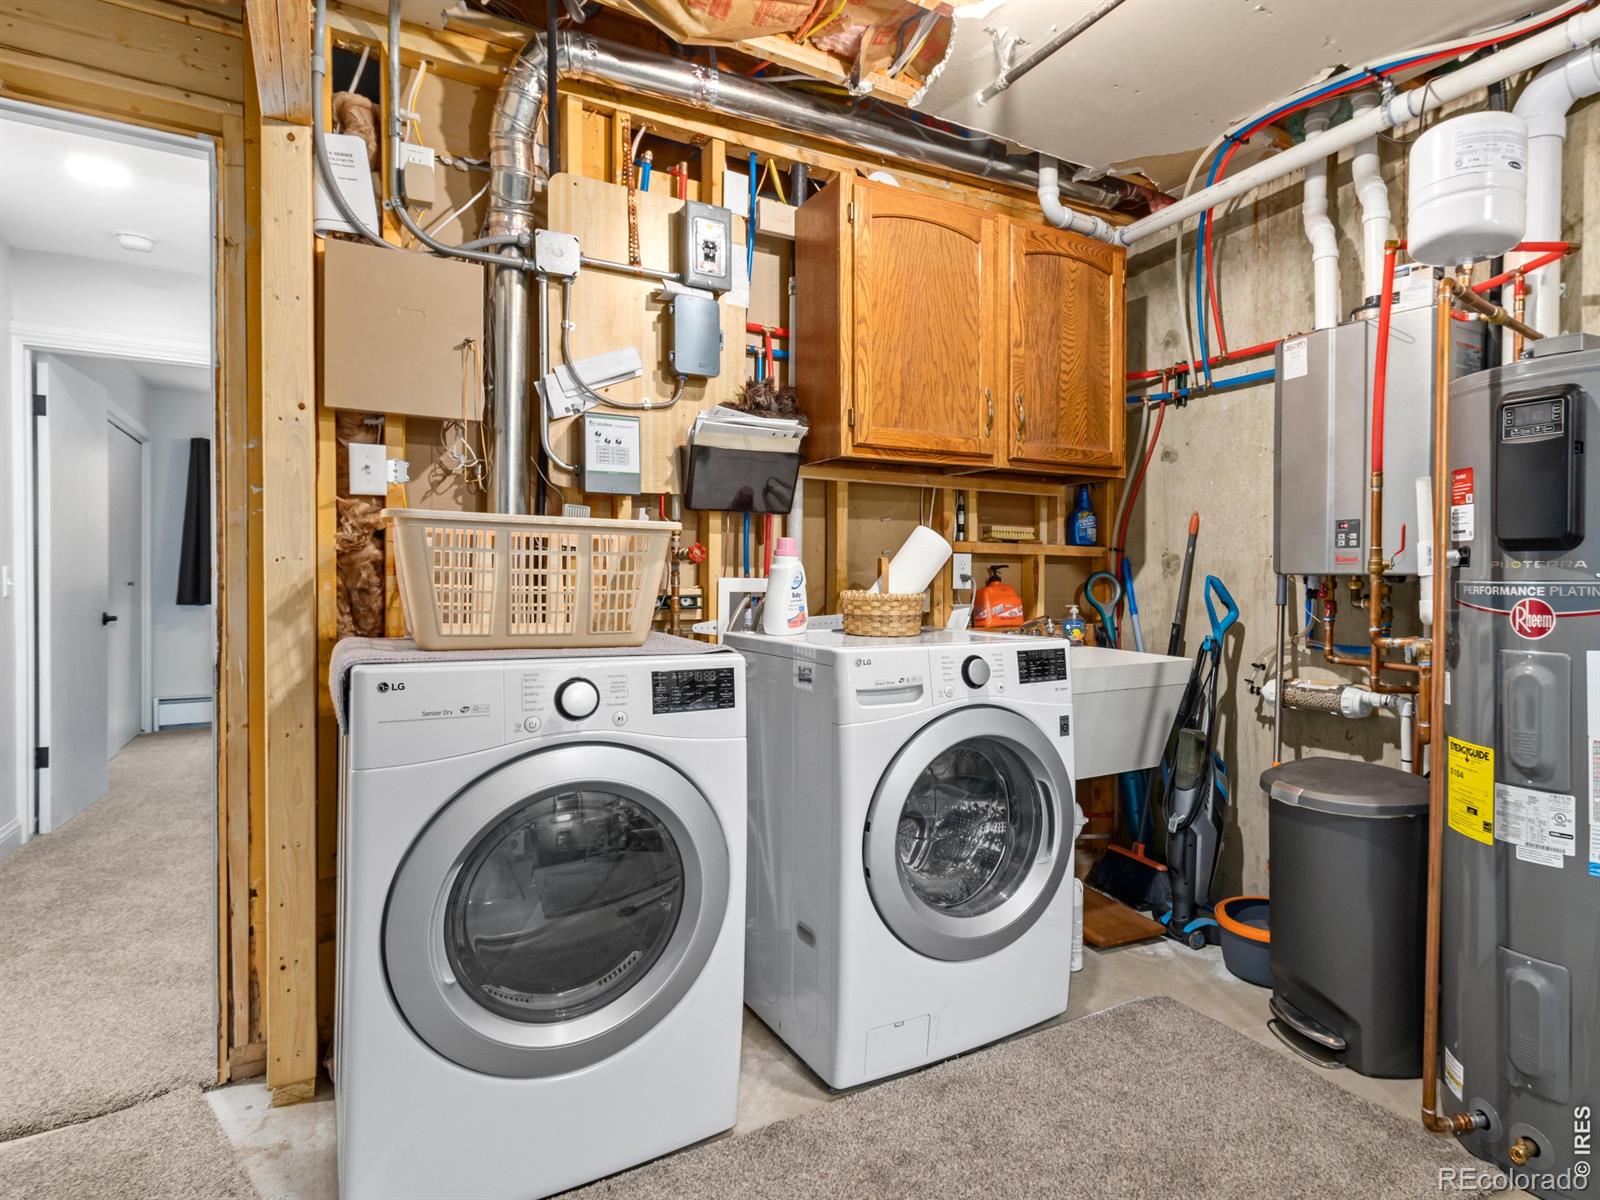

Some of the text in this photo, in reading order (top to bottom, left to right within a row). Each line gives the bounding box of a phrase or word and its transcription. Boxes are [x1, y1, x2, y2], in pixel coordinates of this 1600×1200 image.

[1463, 585, 1545, 597] PERFORMANCE
[1515, 598, 1553, 633] Rheem
[391, 682, 406, 691] LG
[442, 708, 454, 716] Dry
